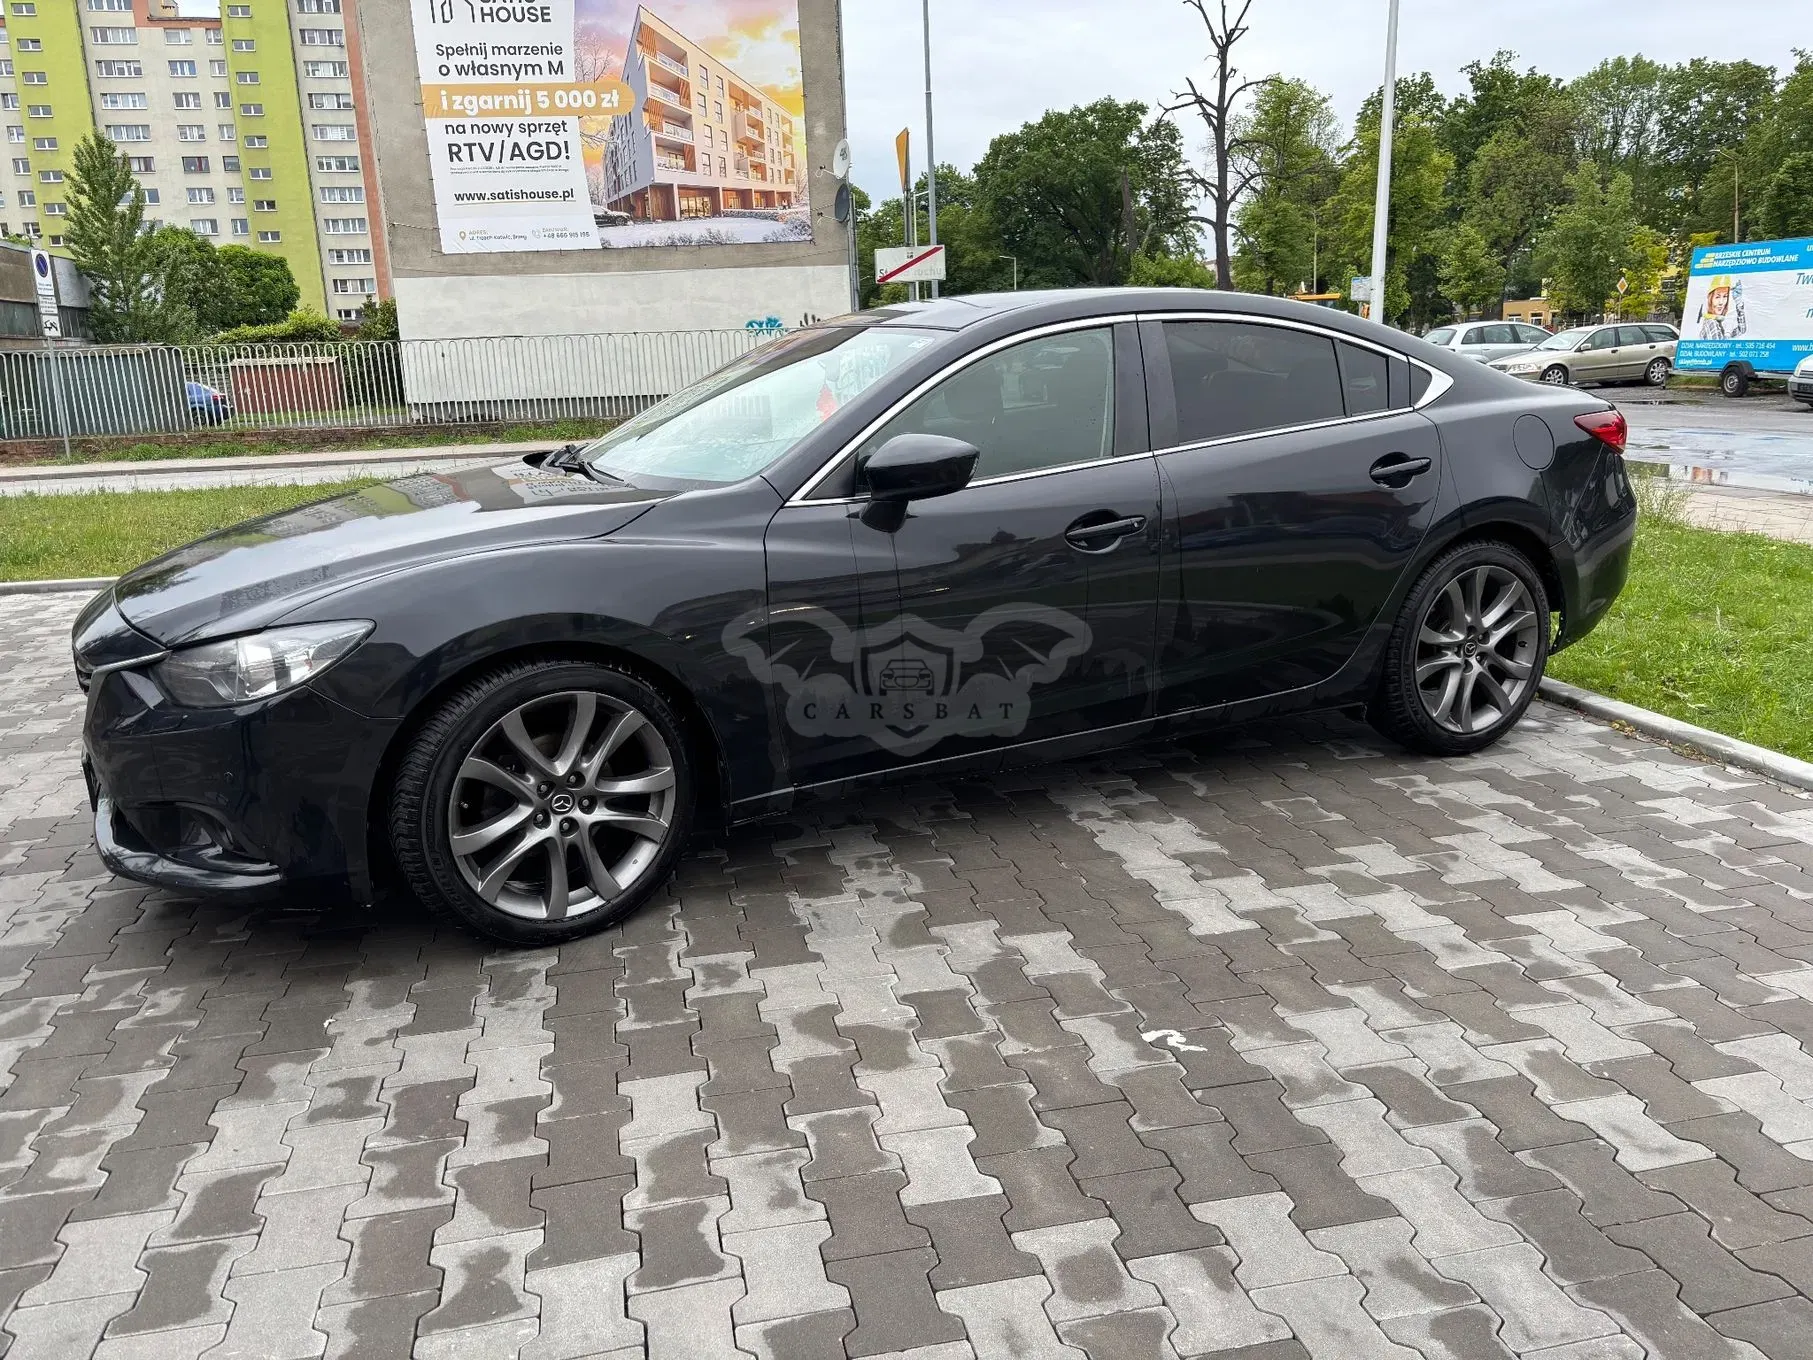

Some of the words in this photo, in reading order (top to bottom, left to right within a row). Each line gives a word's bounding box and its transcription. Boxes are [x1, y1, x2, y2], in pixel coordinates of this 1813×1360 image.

[480, 6, 552, 23] HOUSE
[435, 43, 488, 60] Spełnij
[491, 43, 563, 56] marzenie
[438, 63, 451, 76] o
[455, 60, 543, 81] własnym
[548, 60, 564, 76] M
[440, 89, 448, 110] i
[451, 89, 532, 116] zgarnij
[536, 90, 549, 109] 5
[554, 89, 597, 108] 000
[601, 88, 620, 108] zł
[445, 122, 466, 135] na
[470, 121, 514, 138] nowy
[518, 119, 568, 138] sprzęt
[447, 140, 571, 163] RTV/AGD!
[454, 188, 575, 202] www.satishouse.pl
[1742, 247, 1772, 257] CENTRUM
[1758, 253, 1799, 264] BUDOWLANE
